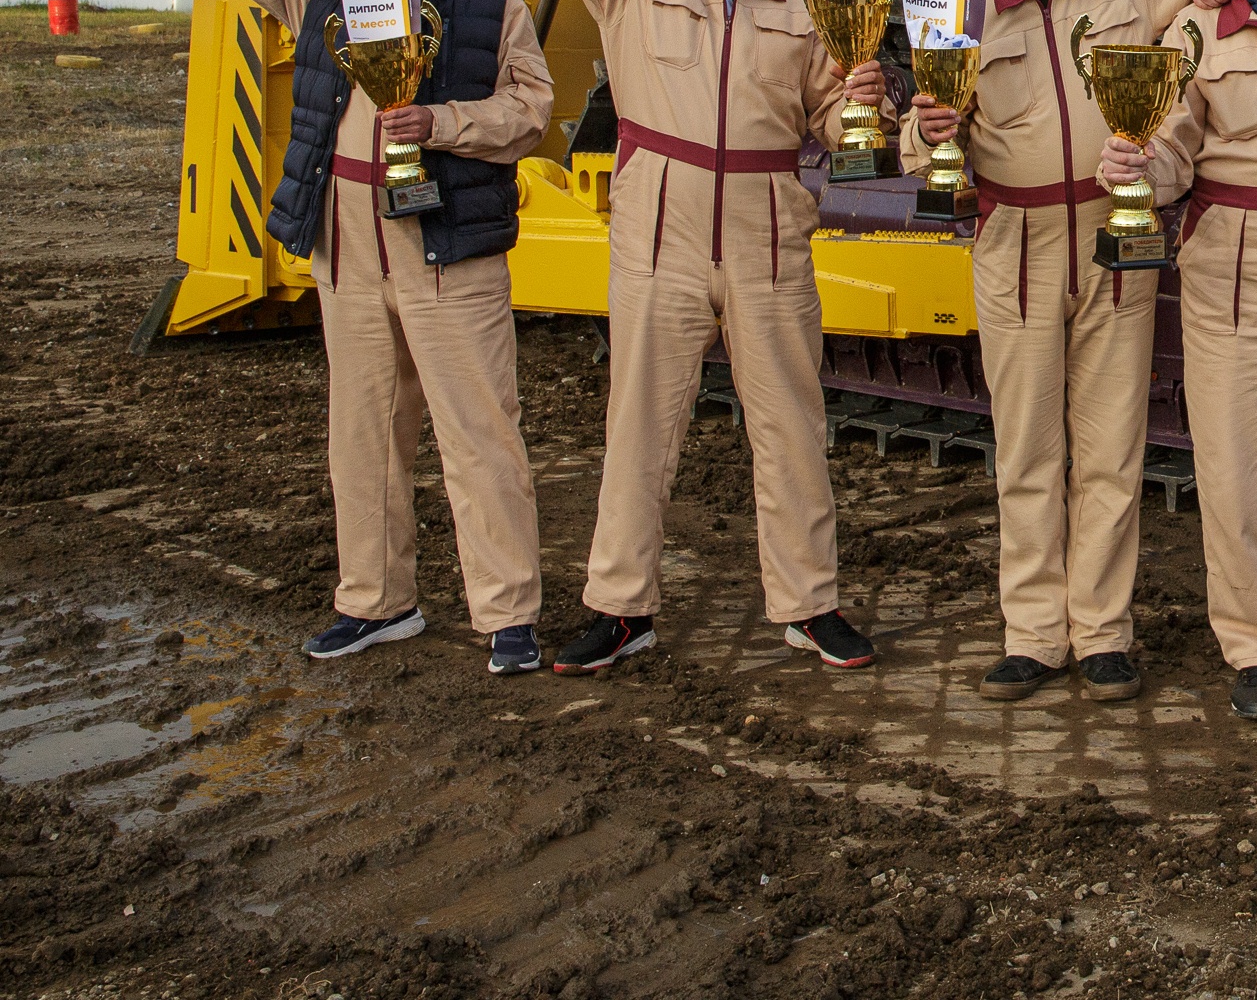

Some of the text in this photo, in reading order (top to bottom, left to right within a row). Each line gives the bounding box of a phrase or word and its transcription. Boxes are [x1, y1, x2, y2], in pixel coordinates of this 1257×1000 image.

[349, 3, 395, 15] ДИПЛОМ
[350, 19, 397, 29] 2 место
[187, 163, 197, 214] 1
